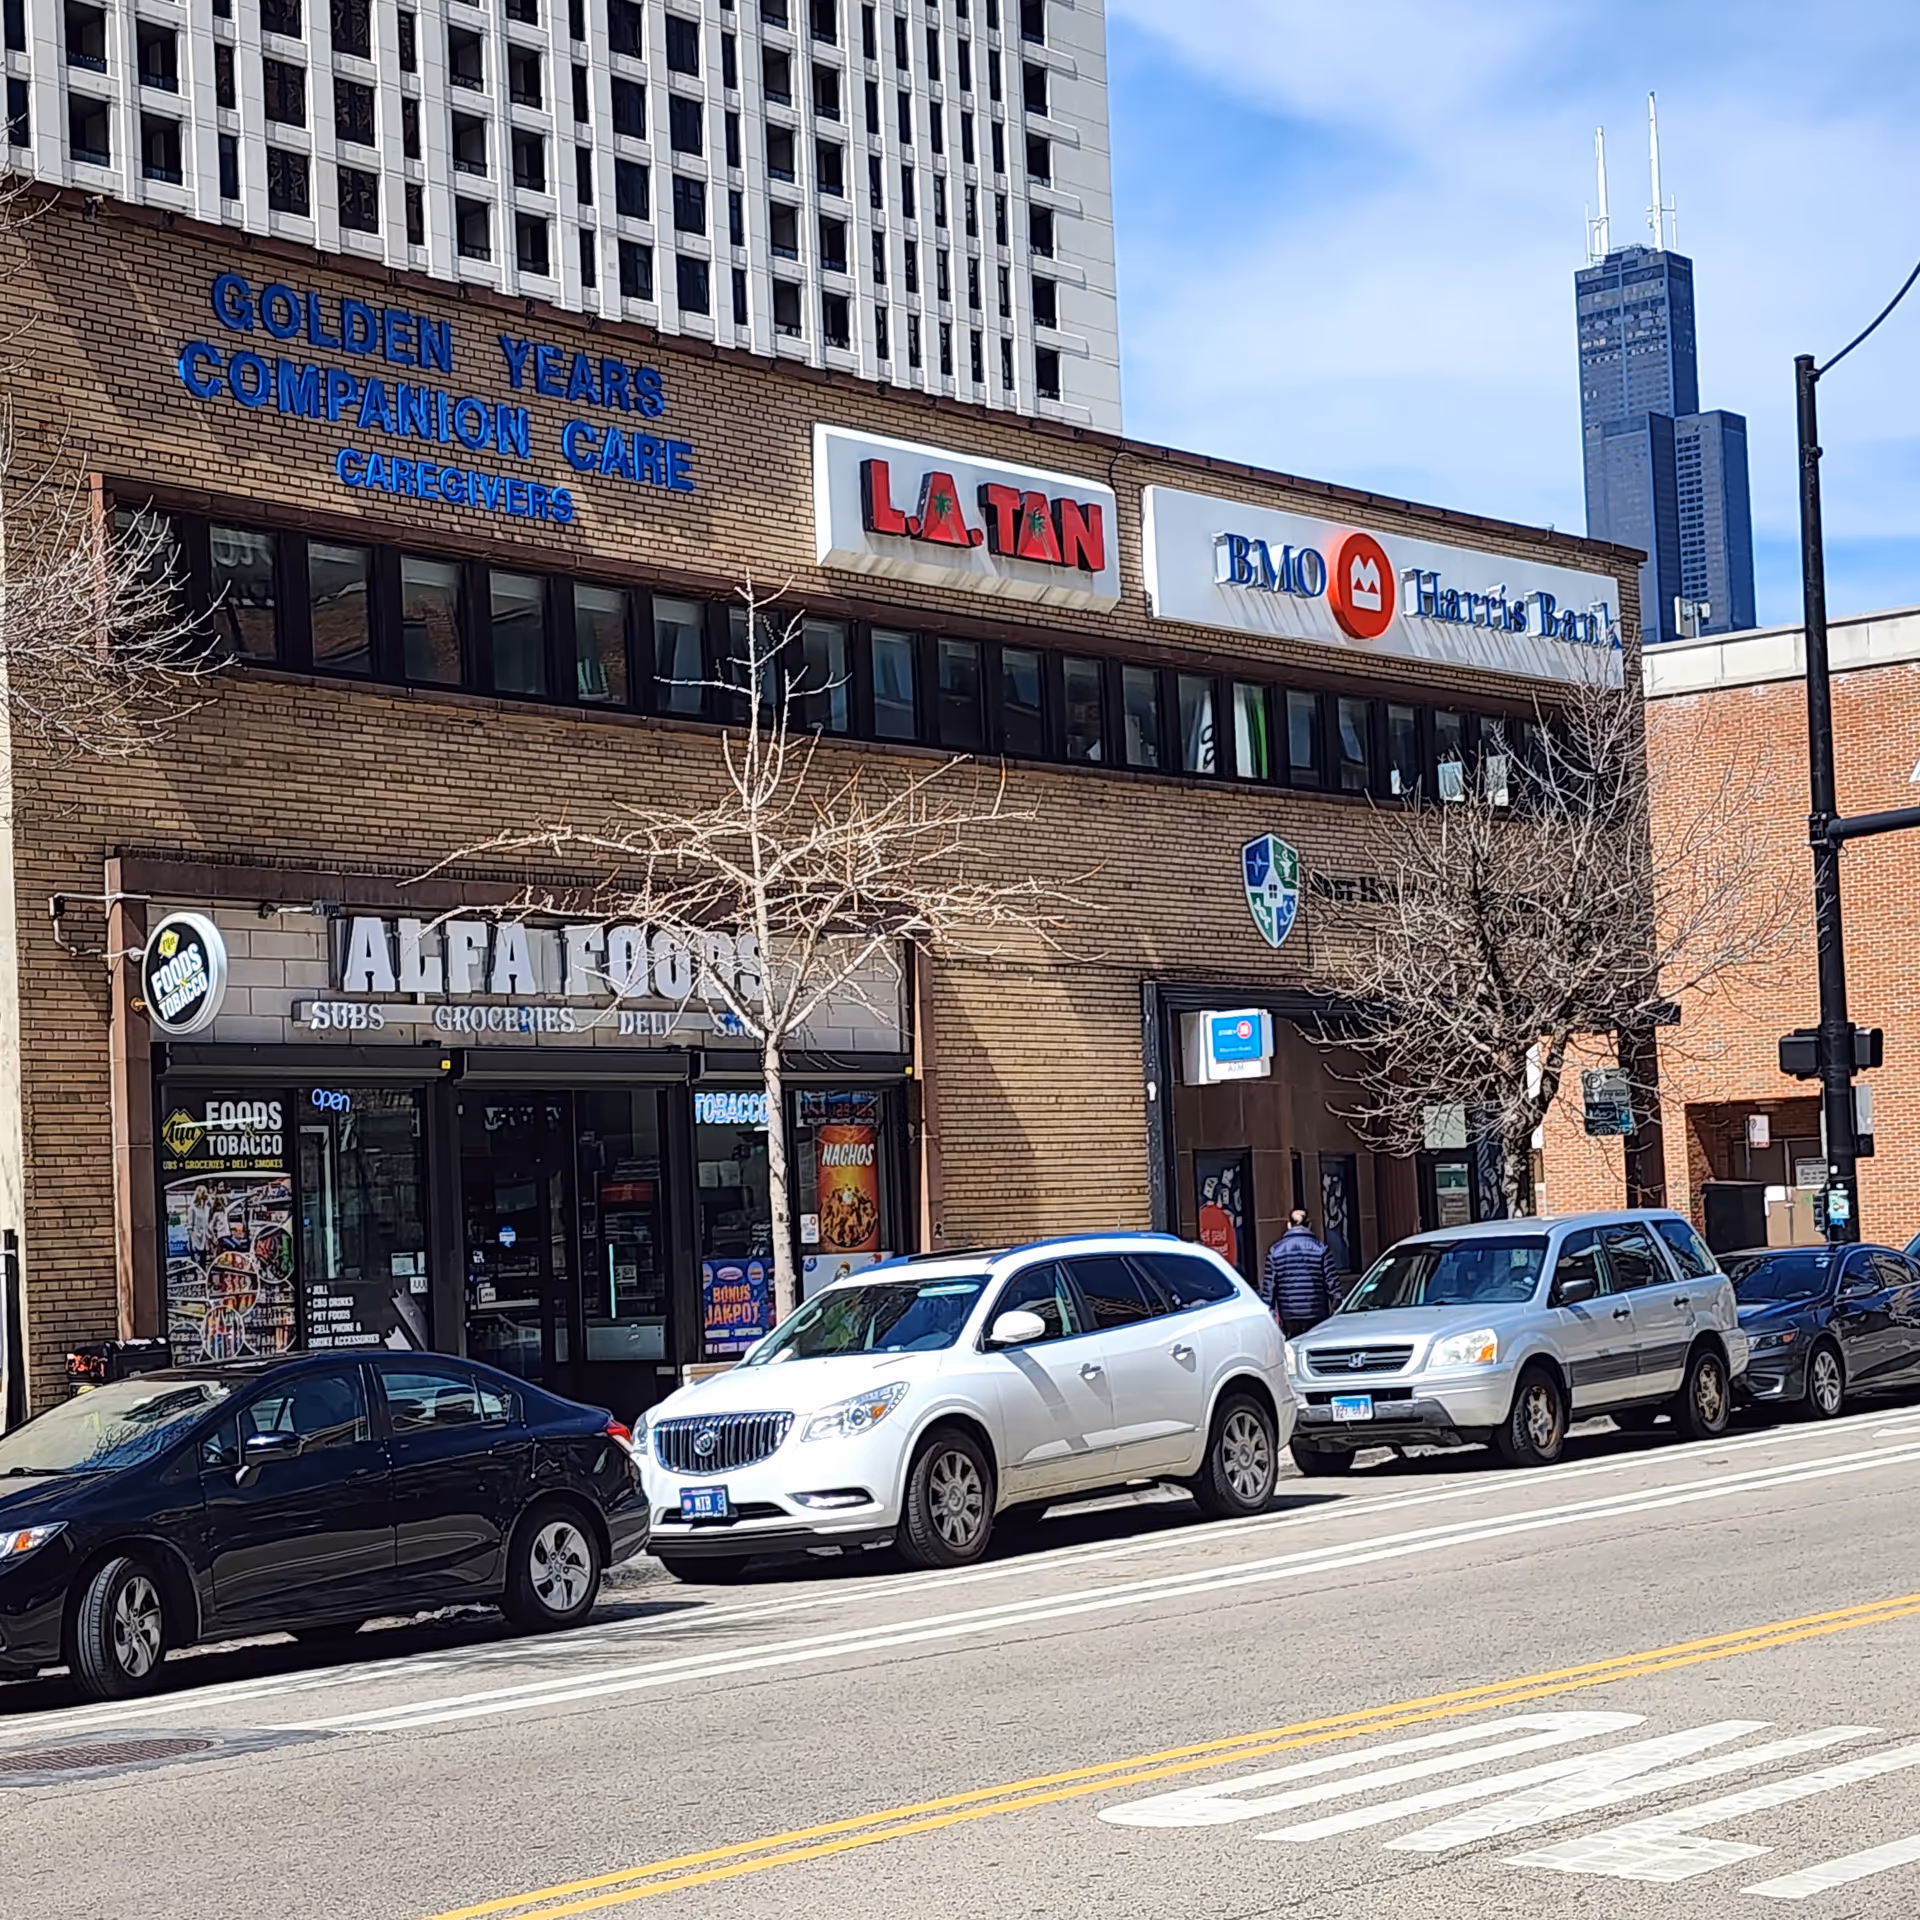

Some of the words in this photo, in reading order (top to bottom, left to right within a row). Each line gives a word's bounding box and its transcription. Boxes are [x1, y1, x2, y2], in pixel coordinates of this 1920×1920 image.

[212, 272, 452, 373] GOLDEN
[499, 335, 663, 417] YEARS
[178, 340, 530, 459] COMPANION
[562, 419, 695, 491] CARE
[336, 447, 574, 524] CAREGIVERS
[861, 458, 984, 548] L.A.
[978, 482, 1105, 572] TAN
[1218, 532, 1327, 598] BMO
[1404, 567, 1528, 633] Harris
[1529, 590, 1624, 650] Bank
[151, 943, 203, 1001] FOODS
[344, 917, 537, 995] ALFA
[565, 922, 764, 1001] FOODS
[159, 971, 208, 1021] TOBACCO
[311, 1001, 385, 1031] SUBS
[435, 1004, 576, 1034] GROCERIES
[618, 1009, 672, 1036] DELI
[205, 1101, 283, 1131] FOODS
[312, 1088, 351, 1113] open
[694, 1092, 770, 1124] TOBACCO
[206, 1134, 283, 1157] TOBACCO
[821, 1143, 875, 1167] NACHOS
[185, 1159, 225, 1170] GROCERIES
[231, 1159, 248, 1169] DELI
[254, 1158, 283, 1169] SMOKES
[712, 1283, 751, 1304] BONUS
[313, 1310, 327, 1322] PET
[328, 1309, 351, 1321] FOODS
[313, 1323, 331, 1335] CELL
[331, 1322, 354, 1334] PHONE
[705, 1301, 760, 1328] JAKPOT
[308, 1336, 333, 1348] SMOKE
[334, 1333, 380, 1346] ACCESSORIES
